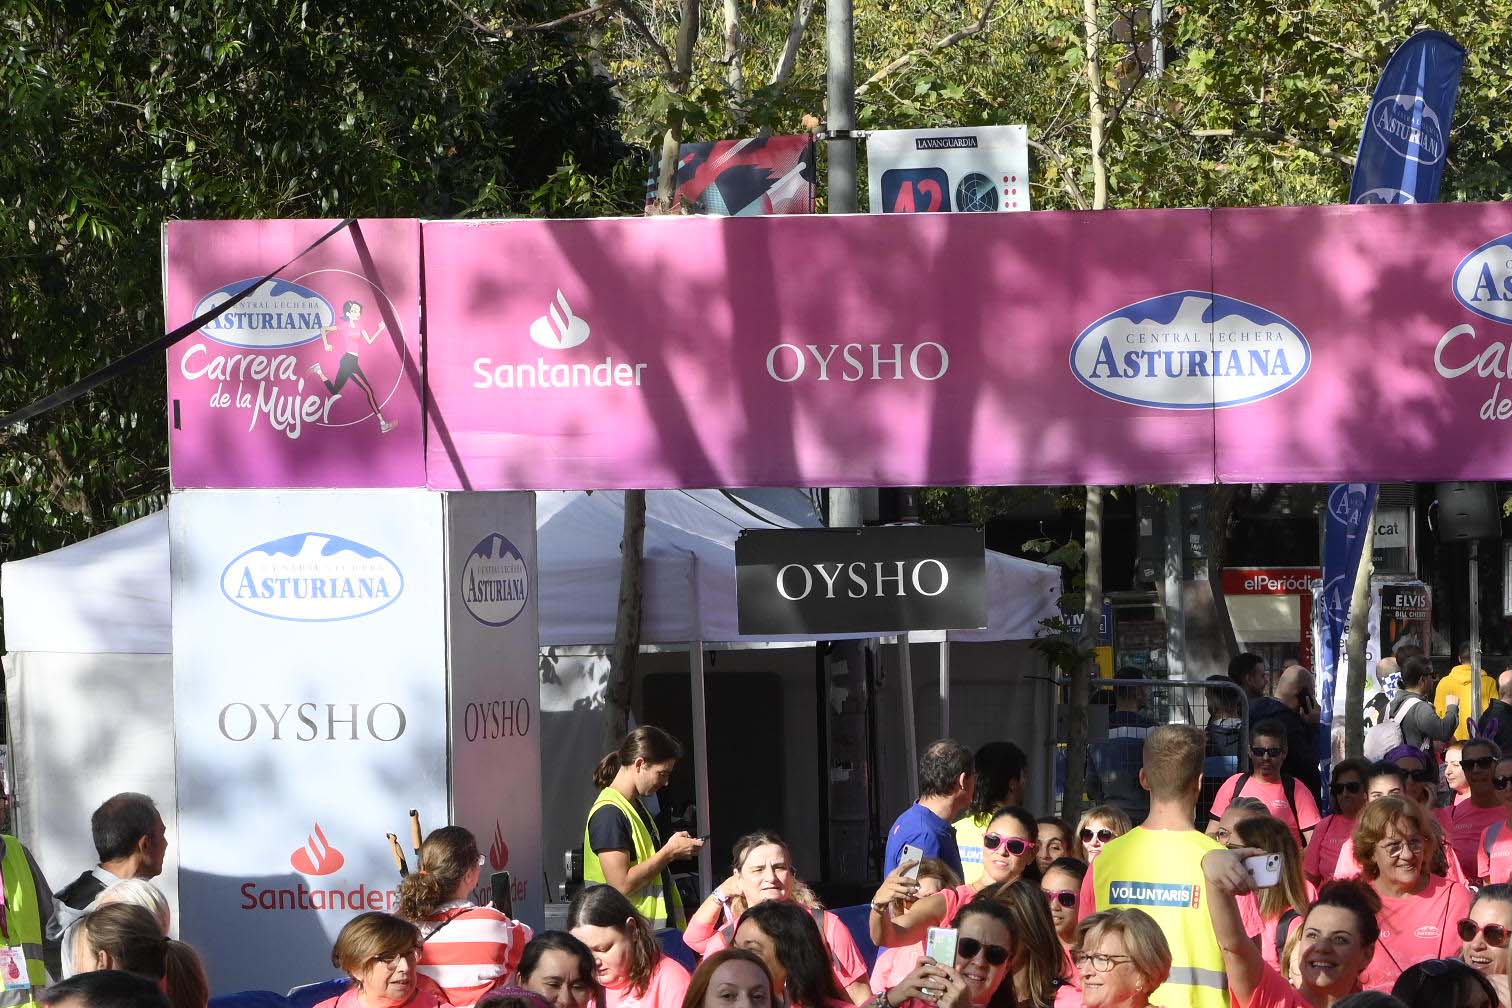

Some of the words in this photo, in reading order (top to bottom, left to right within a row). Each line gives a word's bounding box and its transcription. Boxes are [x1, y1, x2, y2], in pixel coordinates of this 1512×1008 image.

[1126, 332, 1200, 345] CENTRAL
[181, 343, 297, 382] Carrera
[473, 356, 648, 390] Santander
[765, 341, 950, 384] OYSHO
[1089, 335, 1293, 381] ASTURIANA
[209, 383, 232, 409] de
[236, 383, 252, 409] la
[249, 378, 342, 440] Mujer
[236, 565, 391, 600] ASTURIANA
[467, 567, 525, 603] ASTURIANA
[776, 559, 949, 600] OYSHO
[1243, 574, 1314, 592] elPeriódi
[1395, 594, 1426, 607] ELVIS
[218, 702, 407, 742] OYSHO
[464, 697, 531, 743] OYSHO
[240, 882, 397, 912] Santander
[1111, 887, 1190, 902] VOLUNTARIS
